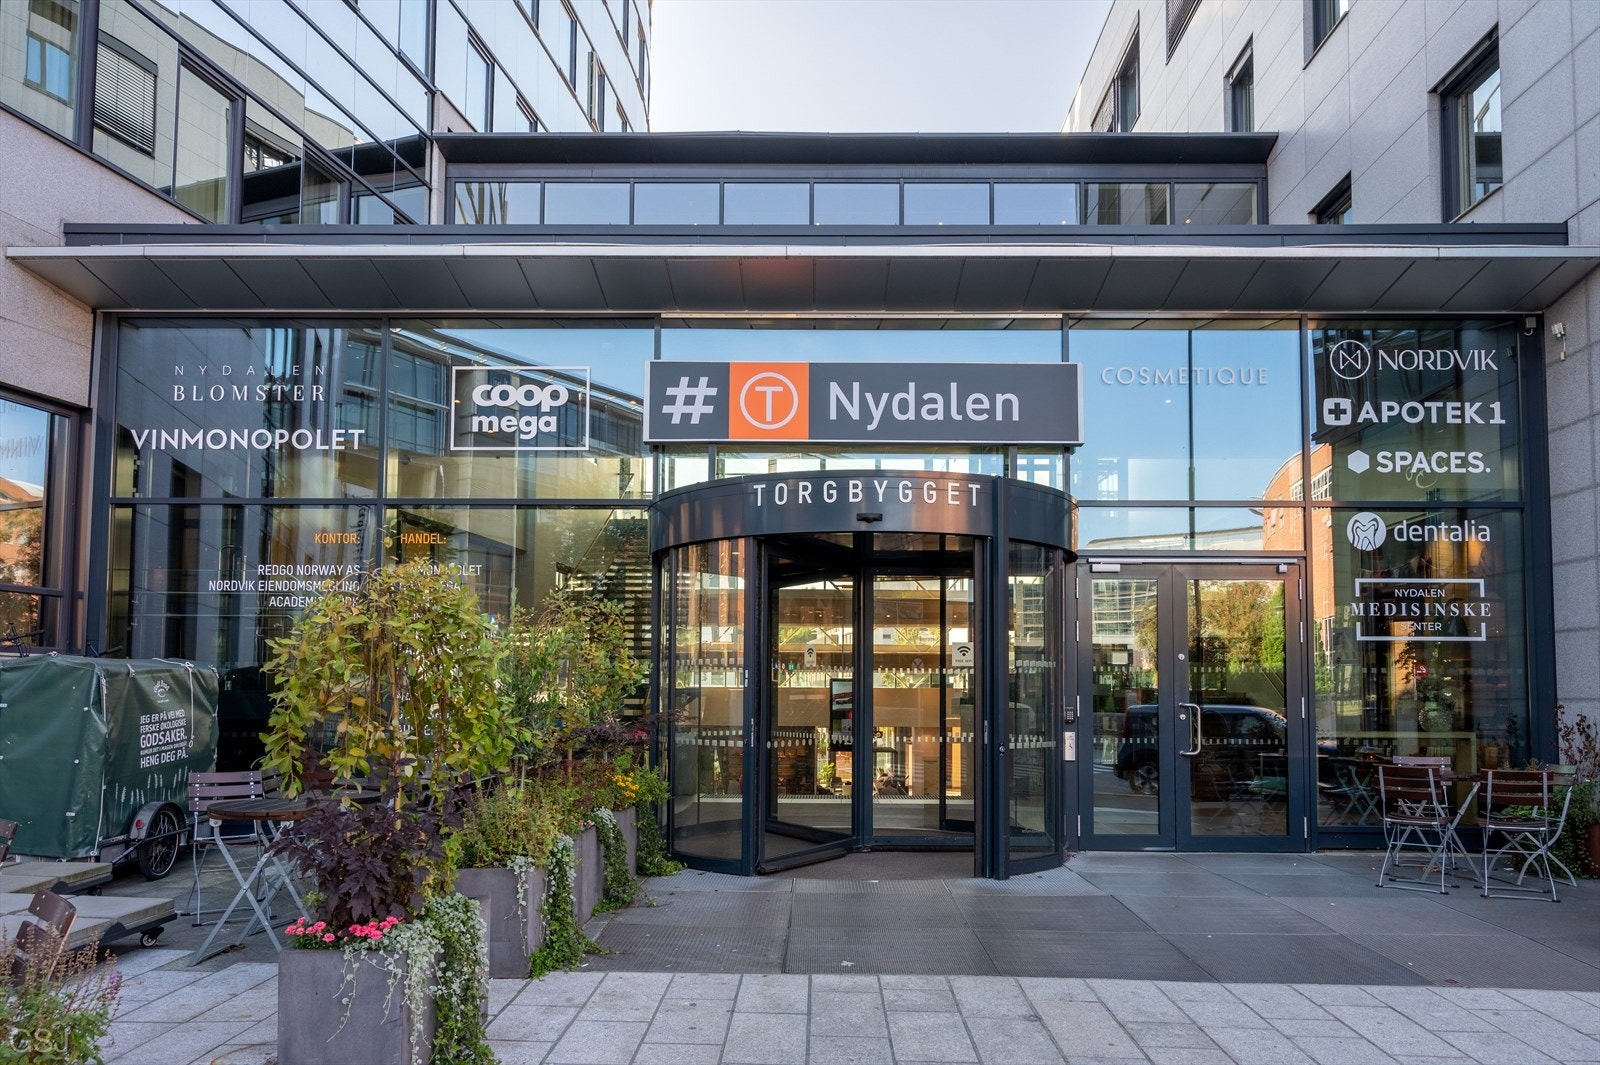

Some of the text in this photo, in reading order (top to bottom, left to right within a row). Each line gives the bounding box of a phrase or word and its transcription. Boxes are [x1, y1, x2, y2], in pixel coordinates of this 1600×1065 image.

[1378, 349, 1499, 371] NORDVIK
[174, 365, 325, 376] NYDALEN
[1101, 367, 1269, 386] COSMETIQUE
[173, 384, 325, 401] BLOMSTER
[472, 384, 569, 412] coop
[661, 376, 718, 425] #
[829, 381, 1020, 431] Nydalen
[1357, 401, 1506, 424] APOTEK 1
[472, 415, 557, 440] mega
[131, 428, 365, 450] VINMONOPOLET
[1376, 451, 1491, 474] SPACES.
[753, 479, 981, 507] TORGBYGGET
[314, 532, 361, 544] KONTOR:
[400, 532, 447, 544] HANDEL:
[1393, 519, 1491, 542] dentalia
[257, 564, 361, 576] REDGO NORWAY AS
[209, 580, 255, 592] NORDVIK
[1394, 588, 1445, 598] NYDALEN
[1350, 602, 1492, 617] MEDISINSKE
[1400, 622, 1442, 631] SENTER
[140, 753, 160, 768] HENG
[160, 750, 176, 764] DEG
